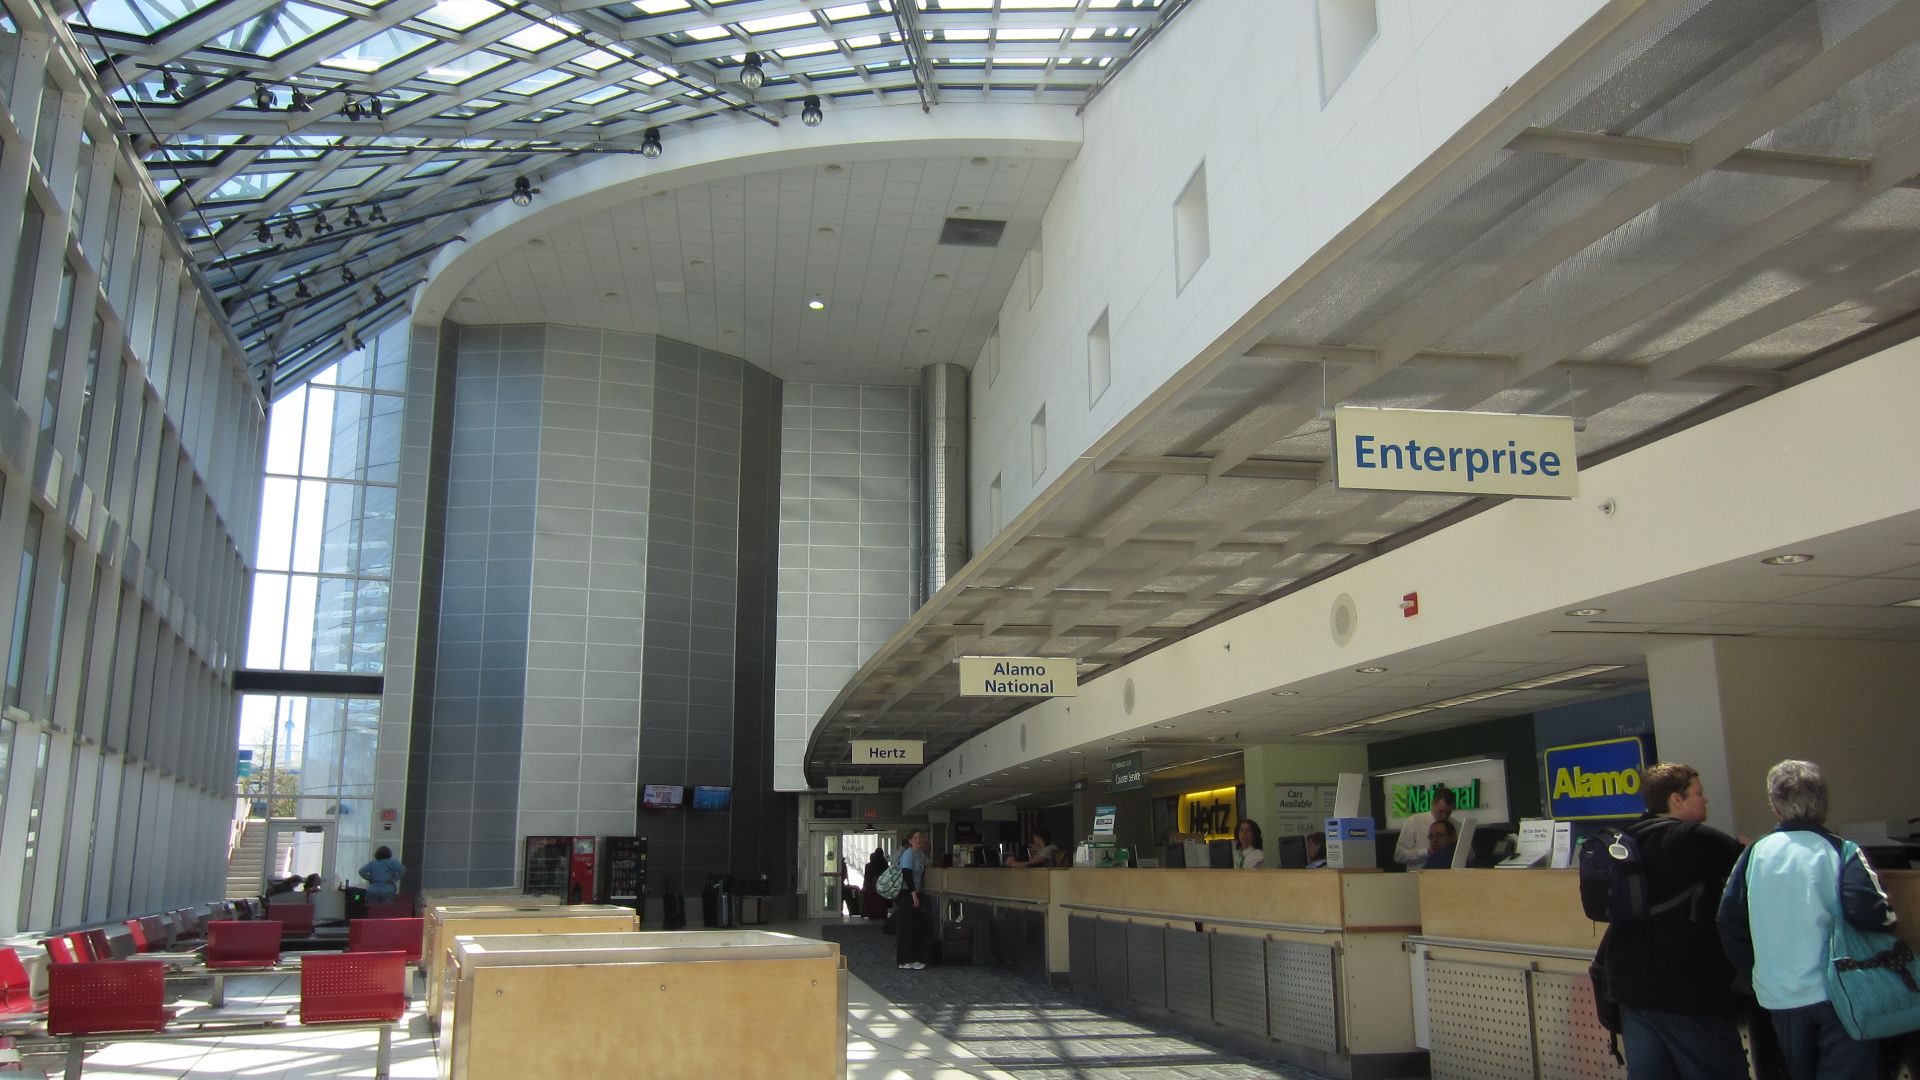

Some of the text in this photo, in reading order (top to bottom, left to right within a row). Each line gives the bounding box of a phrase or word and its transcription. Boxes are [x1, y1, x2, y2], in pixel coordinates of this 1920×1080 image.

[1355, 434, 1561, 482] Enterprise
[993, 661, 1046, 676] Alamo
[985, 679, 1054, 693] National
[869, 747, 906, 759] Hertz
[841, 785, 865, 793] Budget
[1553, 765, 1641, 800] Alamo
[1190, 798, 1232, 834] Hertz
